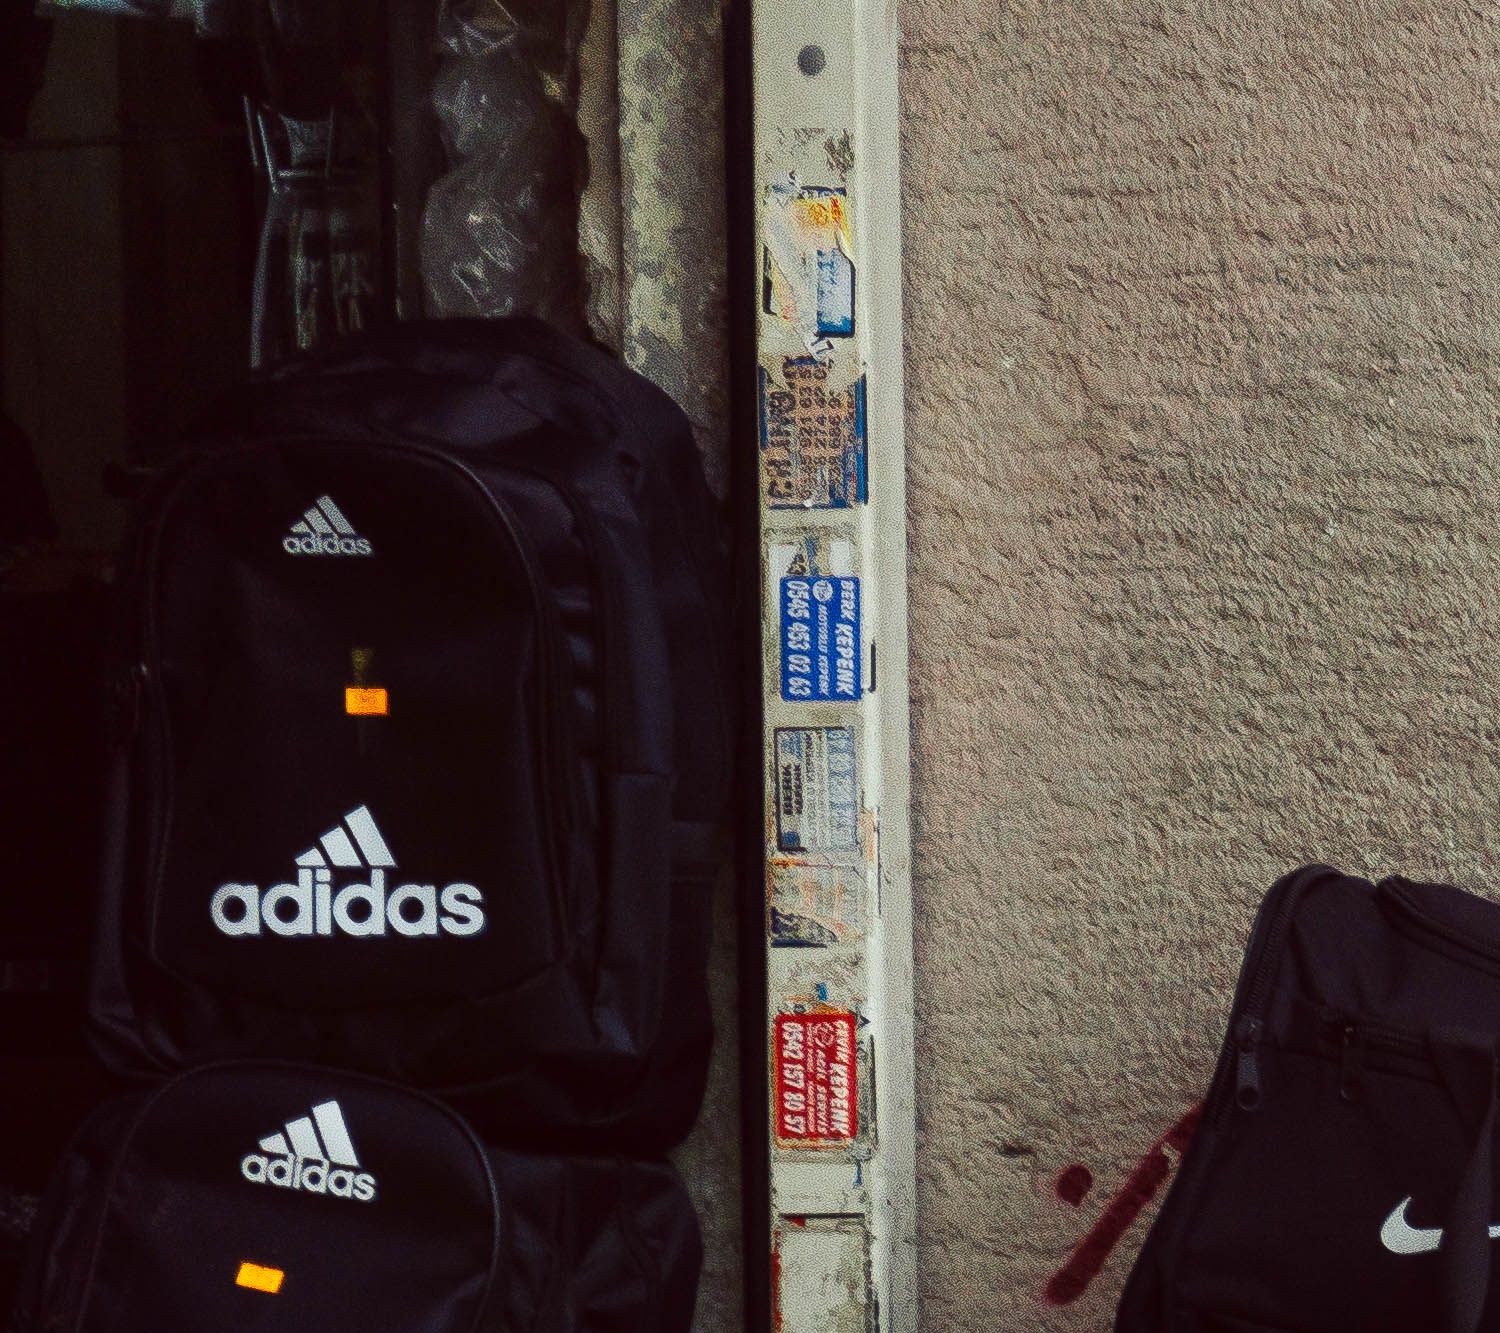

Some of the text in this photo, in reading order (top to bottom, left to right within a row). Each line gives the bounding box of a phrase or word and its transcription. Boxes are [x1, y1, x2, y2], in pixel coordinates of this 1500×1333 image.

[282, 527, 373, 557] adidas
[786, 579, 811, 618] 0545
[787, 622, 811, 651] 453
[835, 580, 856, 697] BERK KEPENK
[787, 676, 812, 697] 63
[210, 867, 486, 937] adidas
[782, 1021, 805, 1060] 0542
[783, 1062, 806, 1090] 157
[829, 1063, 850, 1136] KEPENK
[783, 1114, 806, 1134] 57
[240, 1149, 379, 1202] adidas
